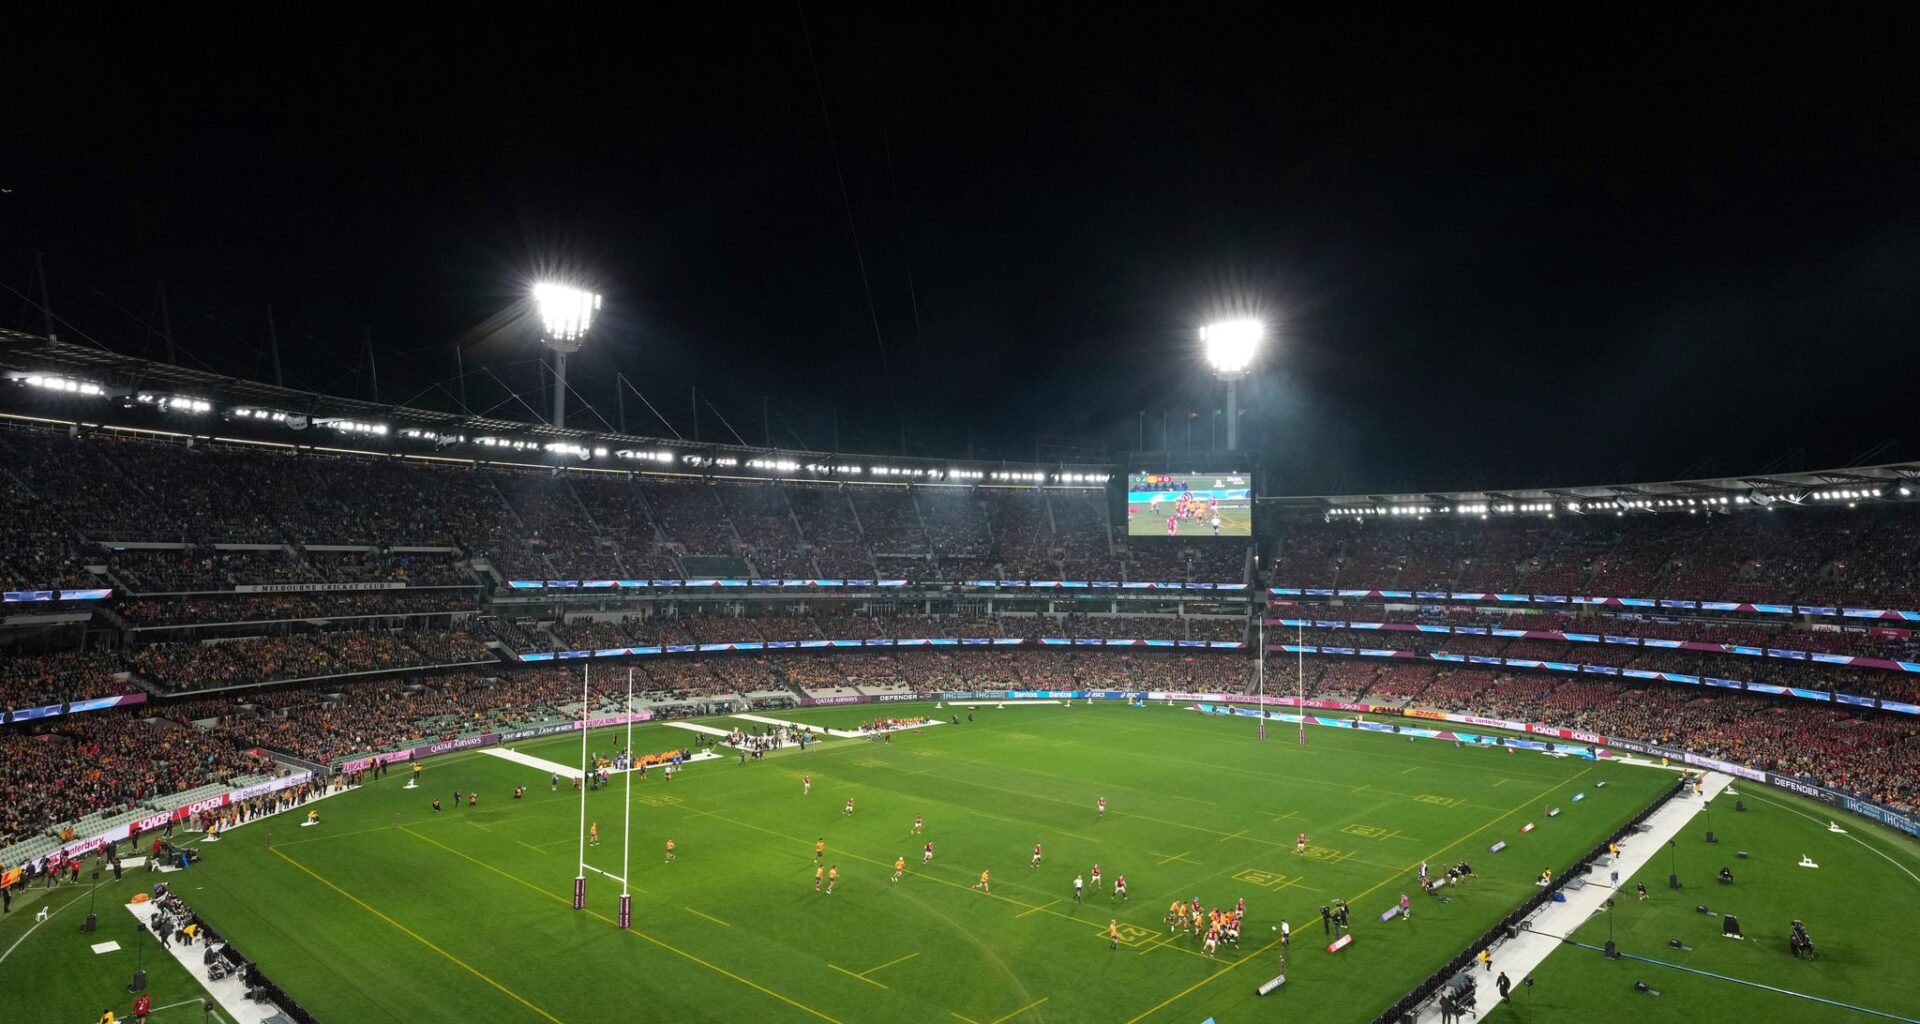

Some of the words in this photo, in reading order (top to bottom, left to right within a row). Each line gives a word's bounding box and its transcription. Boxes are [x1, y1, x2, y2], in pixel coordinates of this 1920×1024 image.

[1415, 710, 1440, 718] DHL
[1475, 717, 1507, 728] canterbury
[431, 742, 452, 753] QATAR
[453, 737, 482, 748] AIRWAYS
[1631, 744, 1644, 752] MEN
[1670, 752, 1683, 761] MEN
[1774, 777, 1819, 798] DEFENDER
[1847, 799, 1863, 813] IHG
[1884, 812, 1900, 827] IHG
